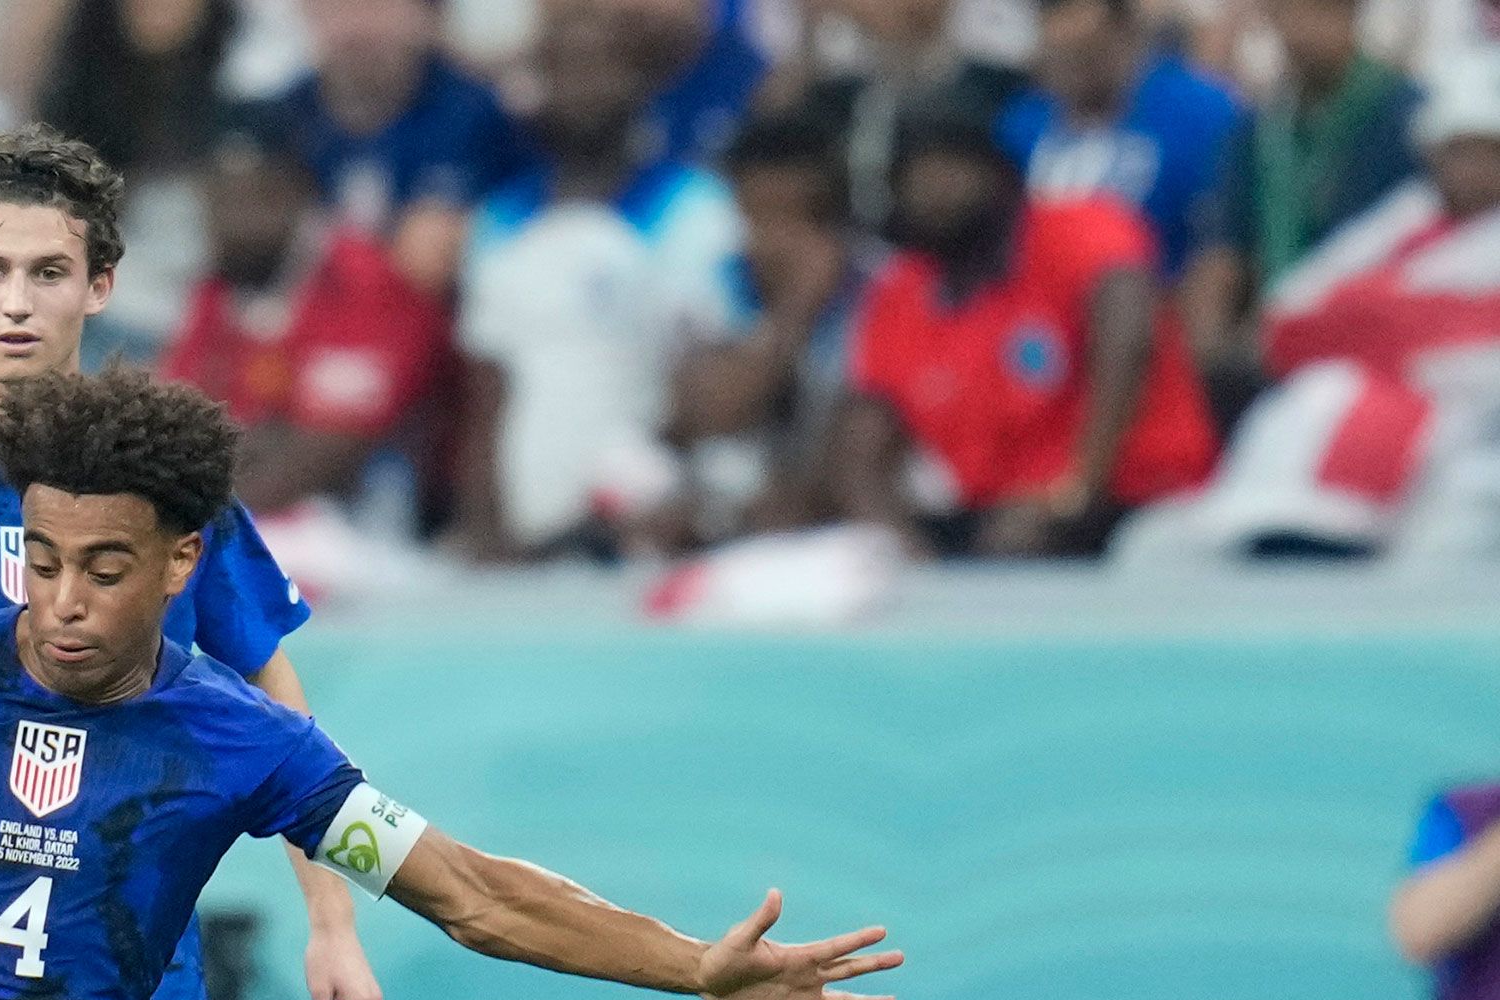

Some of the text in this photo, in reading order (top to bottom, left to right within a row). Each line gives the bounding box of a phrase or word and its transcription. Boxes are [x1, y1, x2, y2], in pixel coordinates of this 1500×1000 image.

[20, 727, 82, 763] USA
[0, 820, 78, 844] ENGLAND VS. USA
[1, 834, 74, 857] AL KHOR, QATAR
[5, 848, 54, 868] NOVEMBER
[55, 856, 80, 871] 2022
